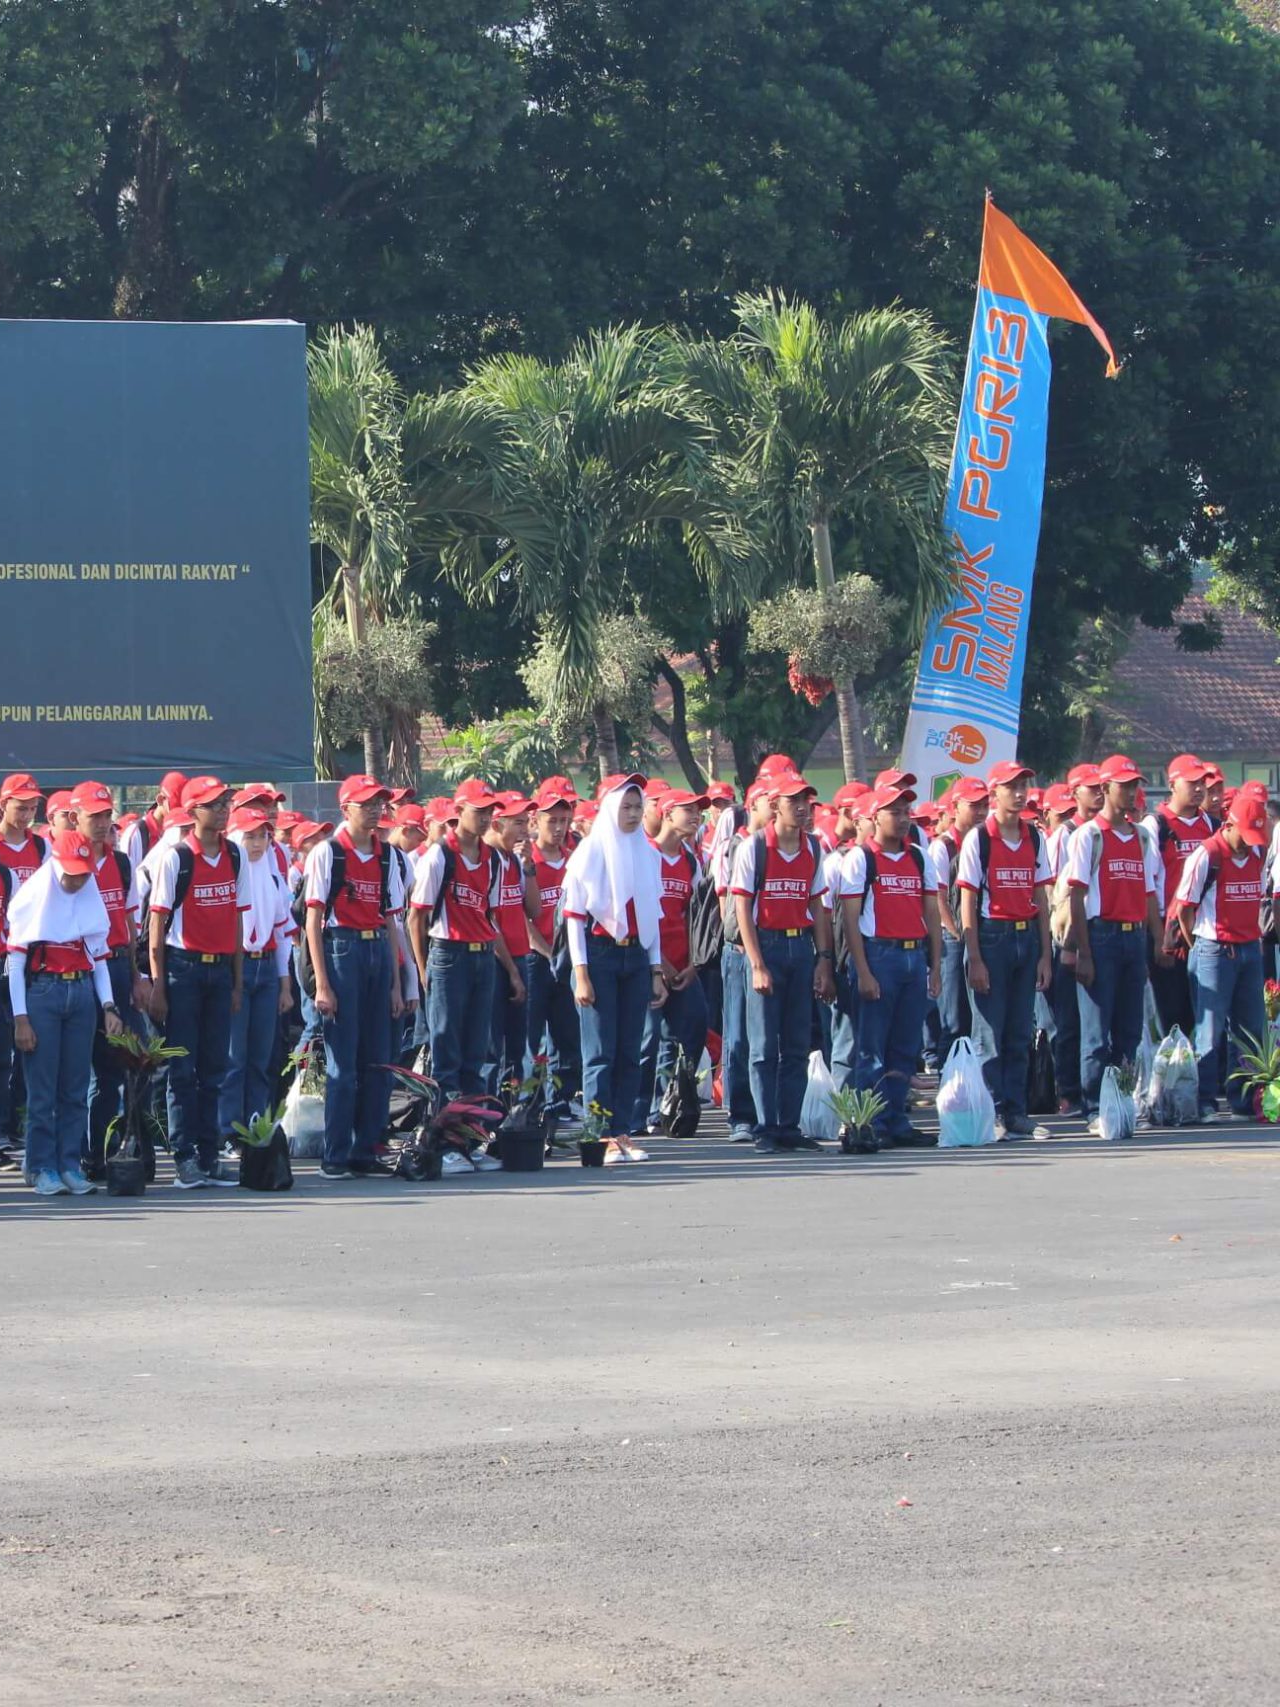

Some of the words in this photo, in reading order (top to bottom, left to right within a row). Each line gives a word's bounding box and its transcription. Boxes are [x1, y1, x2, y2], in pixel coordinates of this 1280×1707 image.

[80, 564, 111, 579] DAN
[114, 564, 177, 580] DICINTAI
[181, 565, 238, 580] RAKYAT
[975, 581, 1024, 691] MALANG
[35, 705, 142, 721] PELANGGARAN
[146, 705, 214, 720] LAINNYA.
